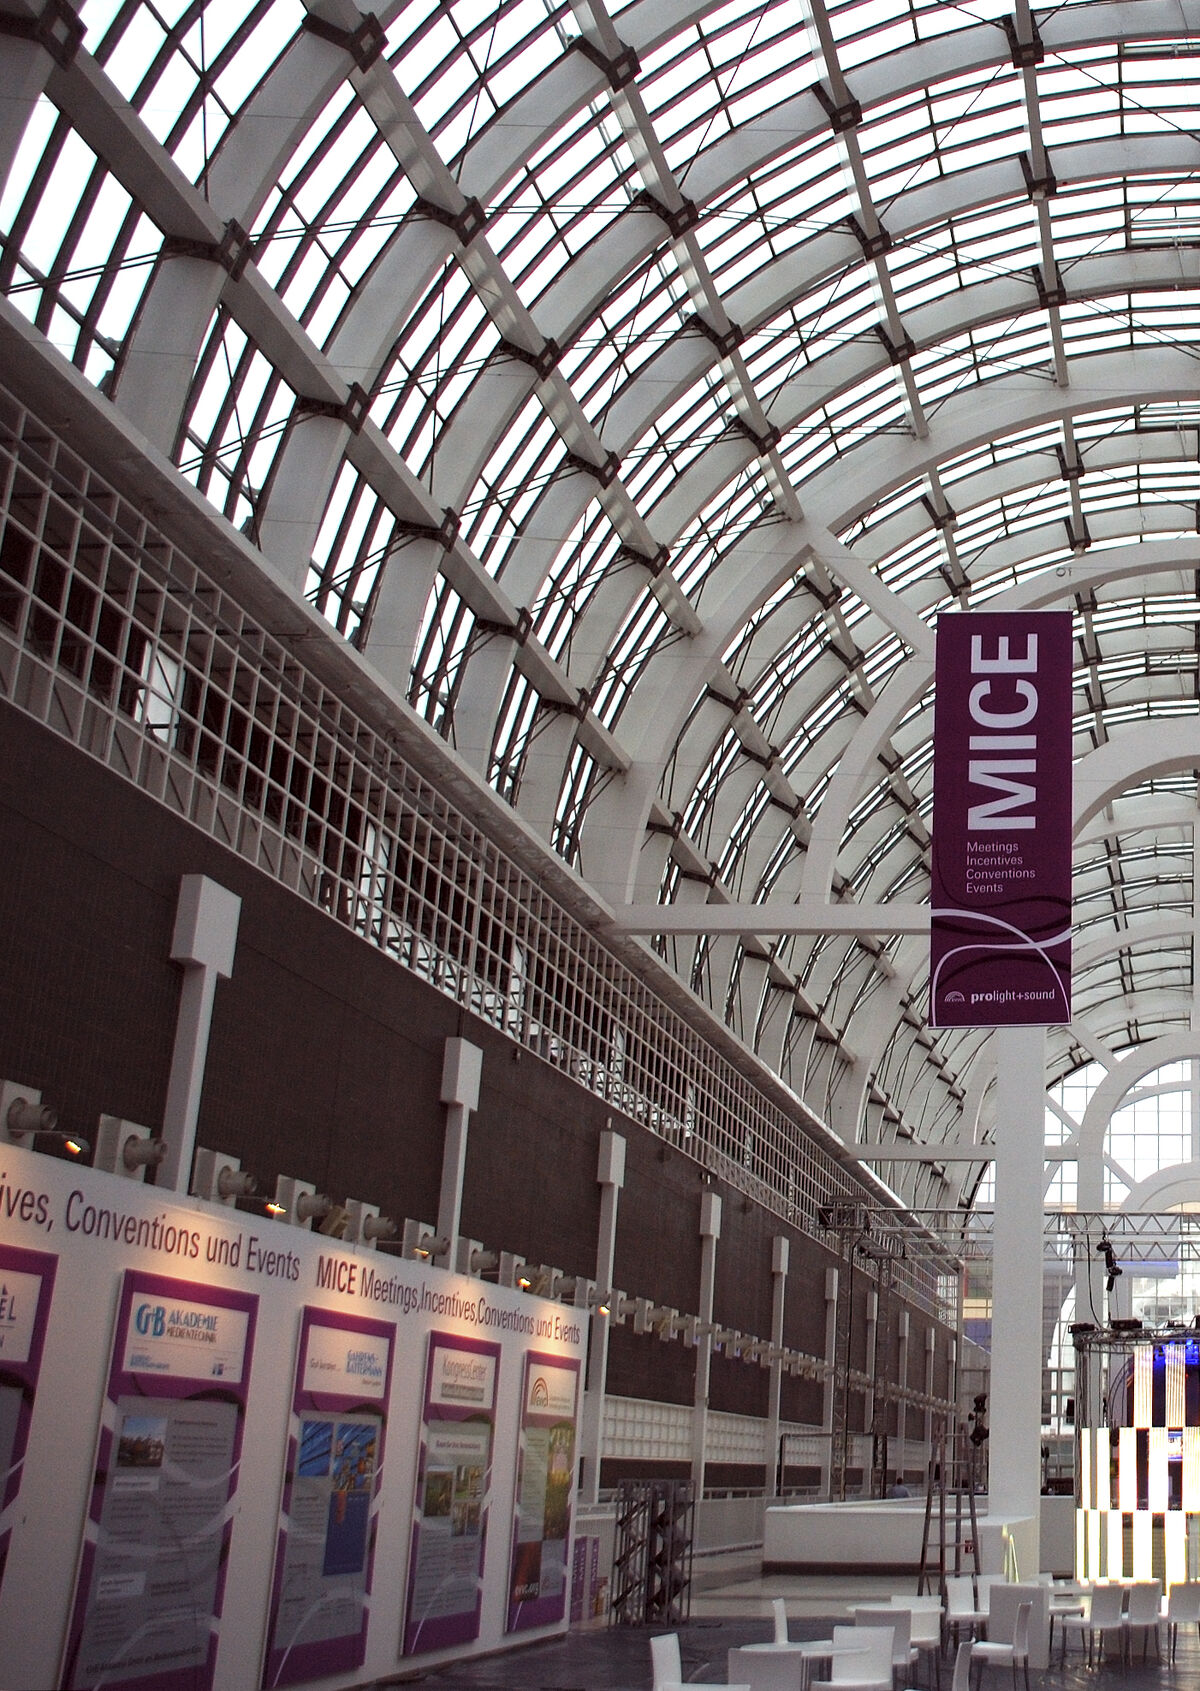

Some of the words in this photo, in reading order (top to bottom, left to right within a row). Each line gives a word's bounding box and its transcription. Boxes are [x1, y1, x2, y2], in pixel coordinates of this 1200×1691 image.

[968, 633, 1038, 830] MICE
[967, 842, 1019, 853] Meetings
[966, 855, 1023, 866] Incentives
[966, 868, 1036, 880] Conventions
[966, 883, 1004, 894] Events
[971, 988, 1055, 1004] prolight+sound
[65, 1190, 200, 1258] Conventions
[206, 1233, 243, 1267] und
[246, 1237, 301, 1281] Events
[316, 1255, 357, 1295] MICE
[537, 1315, 553, 1338] und
[554, 1317, 580, 1344] Events
